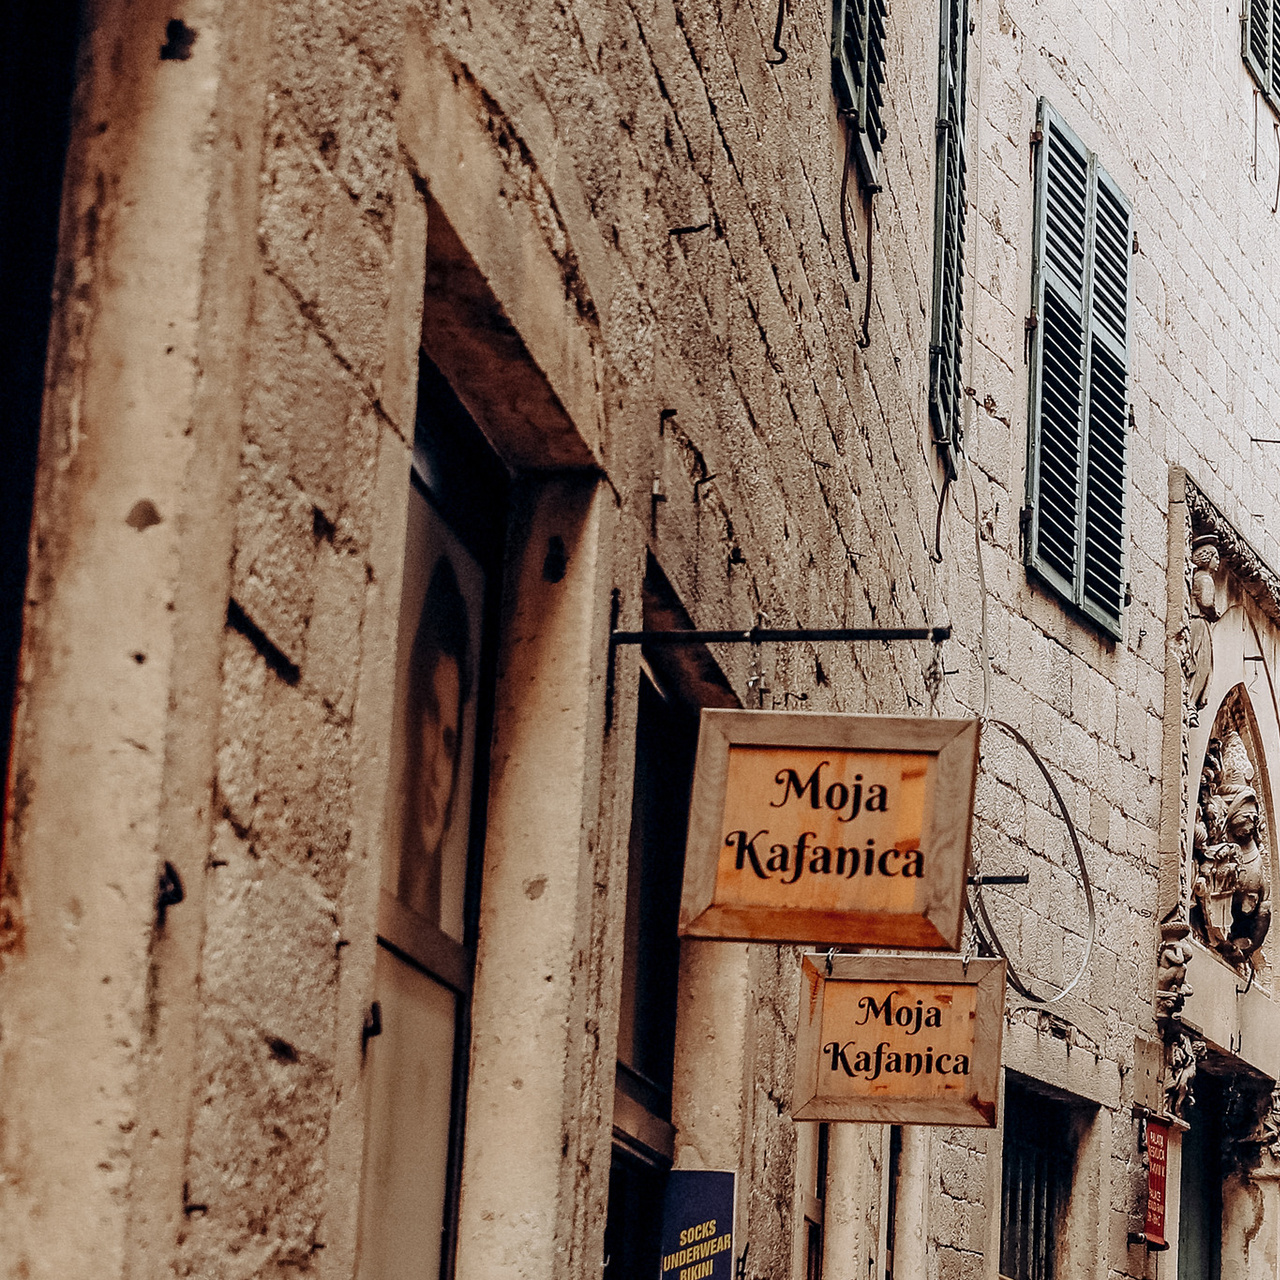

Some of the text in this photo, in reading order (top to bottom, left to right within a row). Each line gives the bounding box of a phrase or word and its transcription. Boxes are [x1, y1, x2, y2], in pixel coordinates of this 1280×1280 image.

[769, 761, 889, 822] Moja
[725, 829, 925, 883] Kafanica
[855, 991, 943, 1036] Moja
[823, 1041, 971, 1080] Kafanica
[663, 1233, 732, 1272] UNDERWEAR
[679, 1219, 717, 1247] SOCKS
